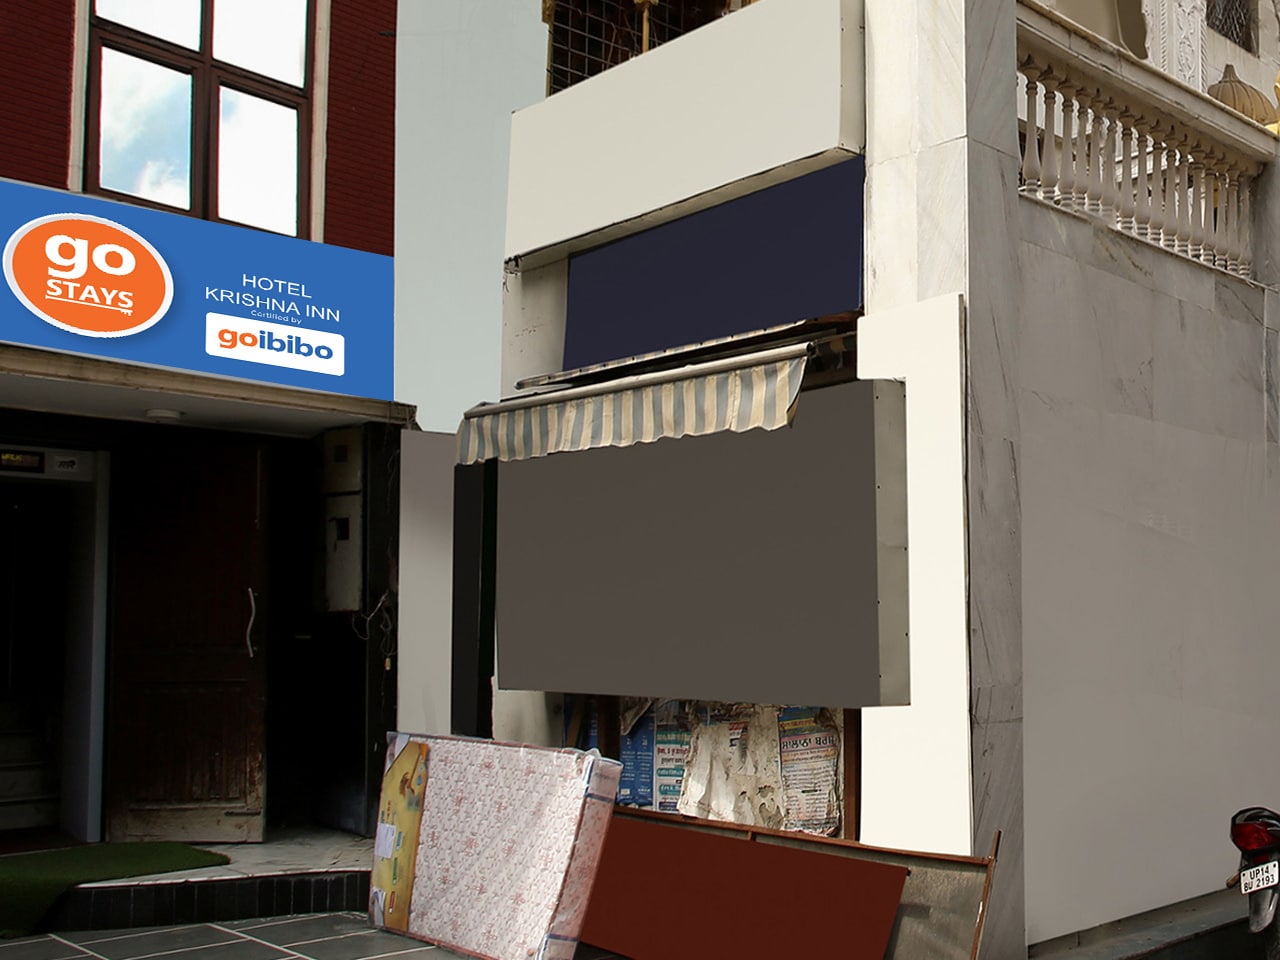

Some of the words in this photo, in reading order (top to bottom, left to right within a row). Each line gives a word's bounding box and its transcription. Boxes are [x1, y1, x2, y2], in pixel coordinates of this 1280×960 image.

[45, 234, 136, 280] go
[46, 278, 134, 309] STAYS
[242, 273, 313, 299] HOTEL
[205, 286, 301, 316] KRISHNA
[306, 304, 340, 322] INN
[250, 309, 290, 322] Certified
[290, 316, 302, 325] by
[217, 328, 334, 360] goibibo
[1249, 866, 1269, 880] UP14
[1256, 874, 1275, 887] 2193
